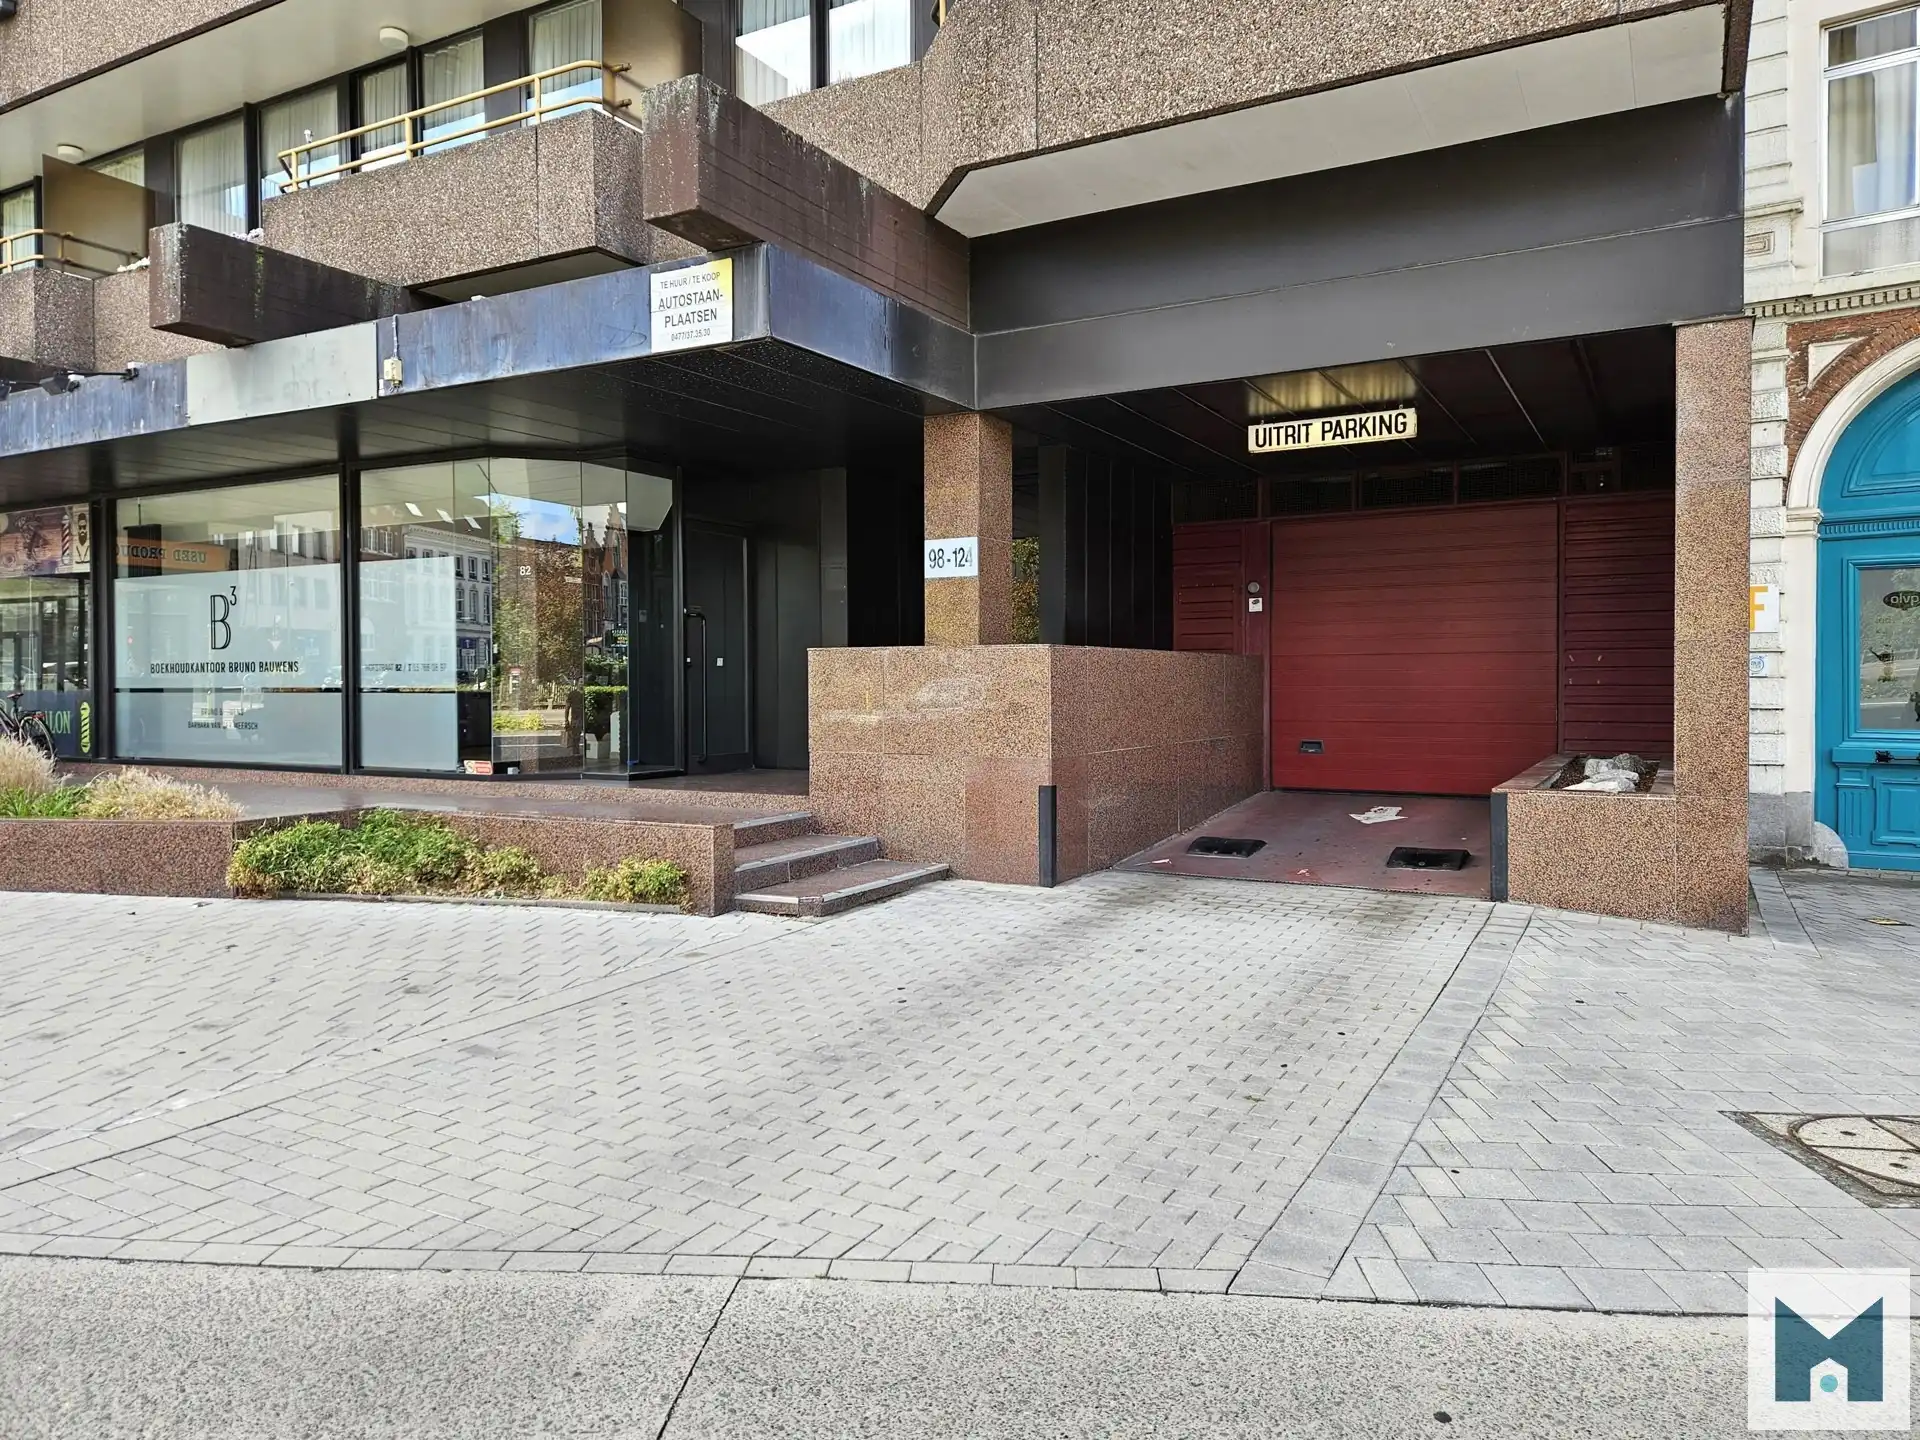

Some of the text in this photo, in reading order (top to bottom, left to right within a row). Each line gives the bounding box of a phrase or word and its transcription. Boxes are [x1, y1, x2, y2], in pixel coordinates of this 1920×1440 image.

[660, 281, 668, 289] TE
[669, 277, 688, 288] HUUR
[692, 275, 700, 284] TE
[701, 272, 720, 282] KOOP
[658, 288, 723, 310] AUTOSTAAN-
[664, 308, 717, 328] PLAATSEN
[1255, 412, 1407, 448] UITRIT PARKING
[519, 565, 531, 576] 82
[150, 660, 299, 674] BOEKHOUDKANTOOR BRUNO BAUWENS
[187, 721, 210, 729] BARBARA
